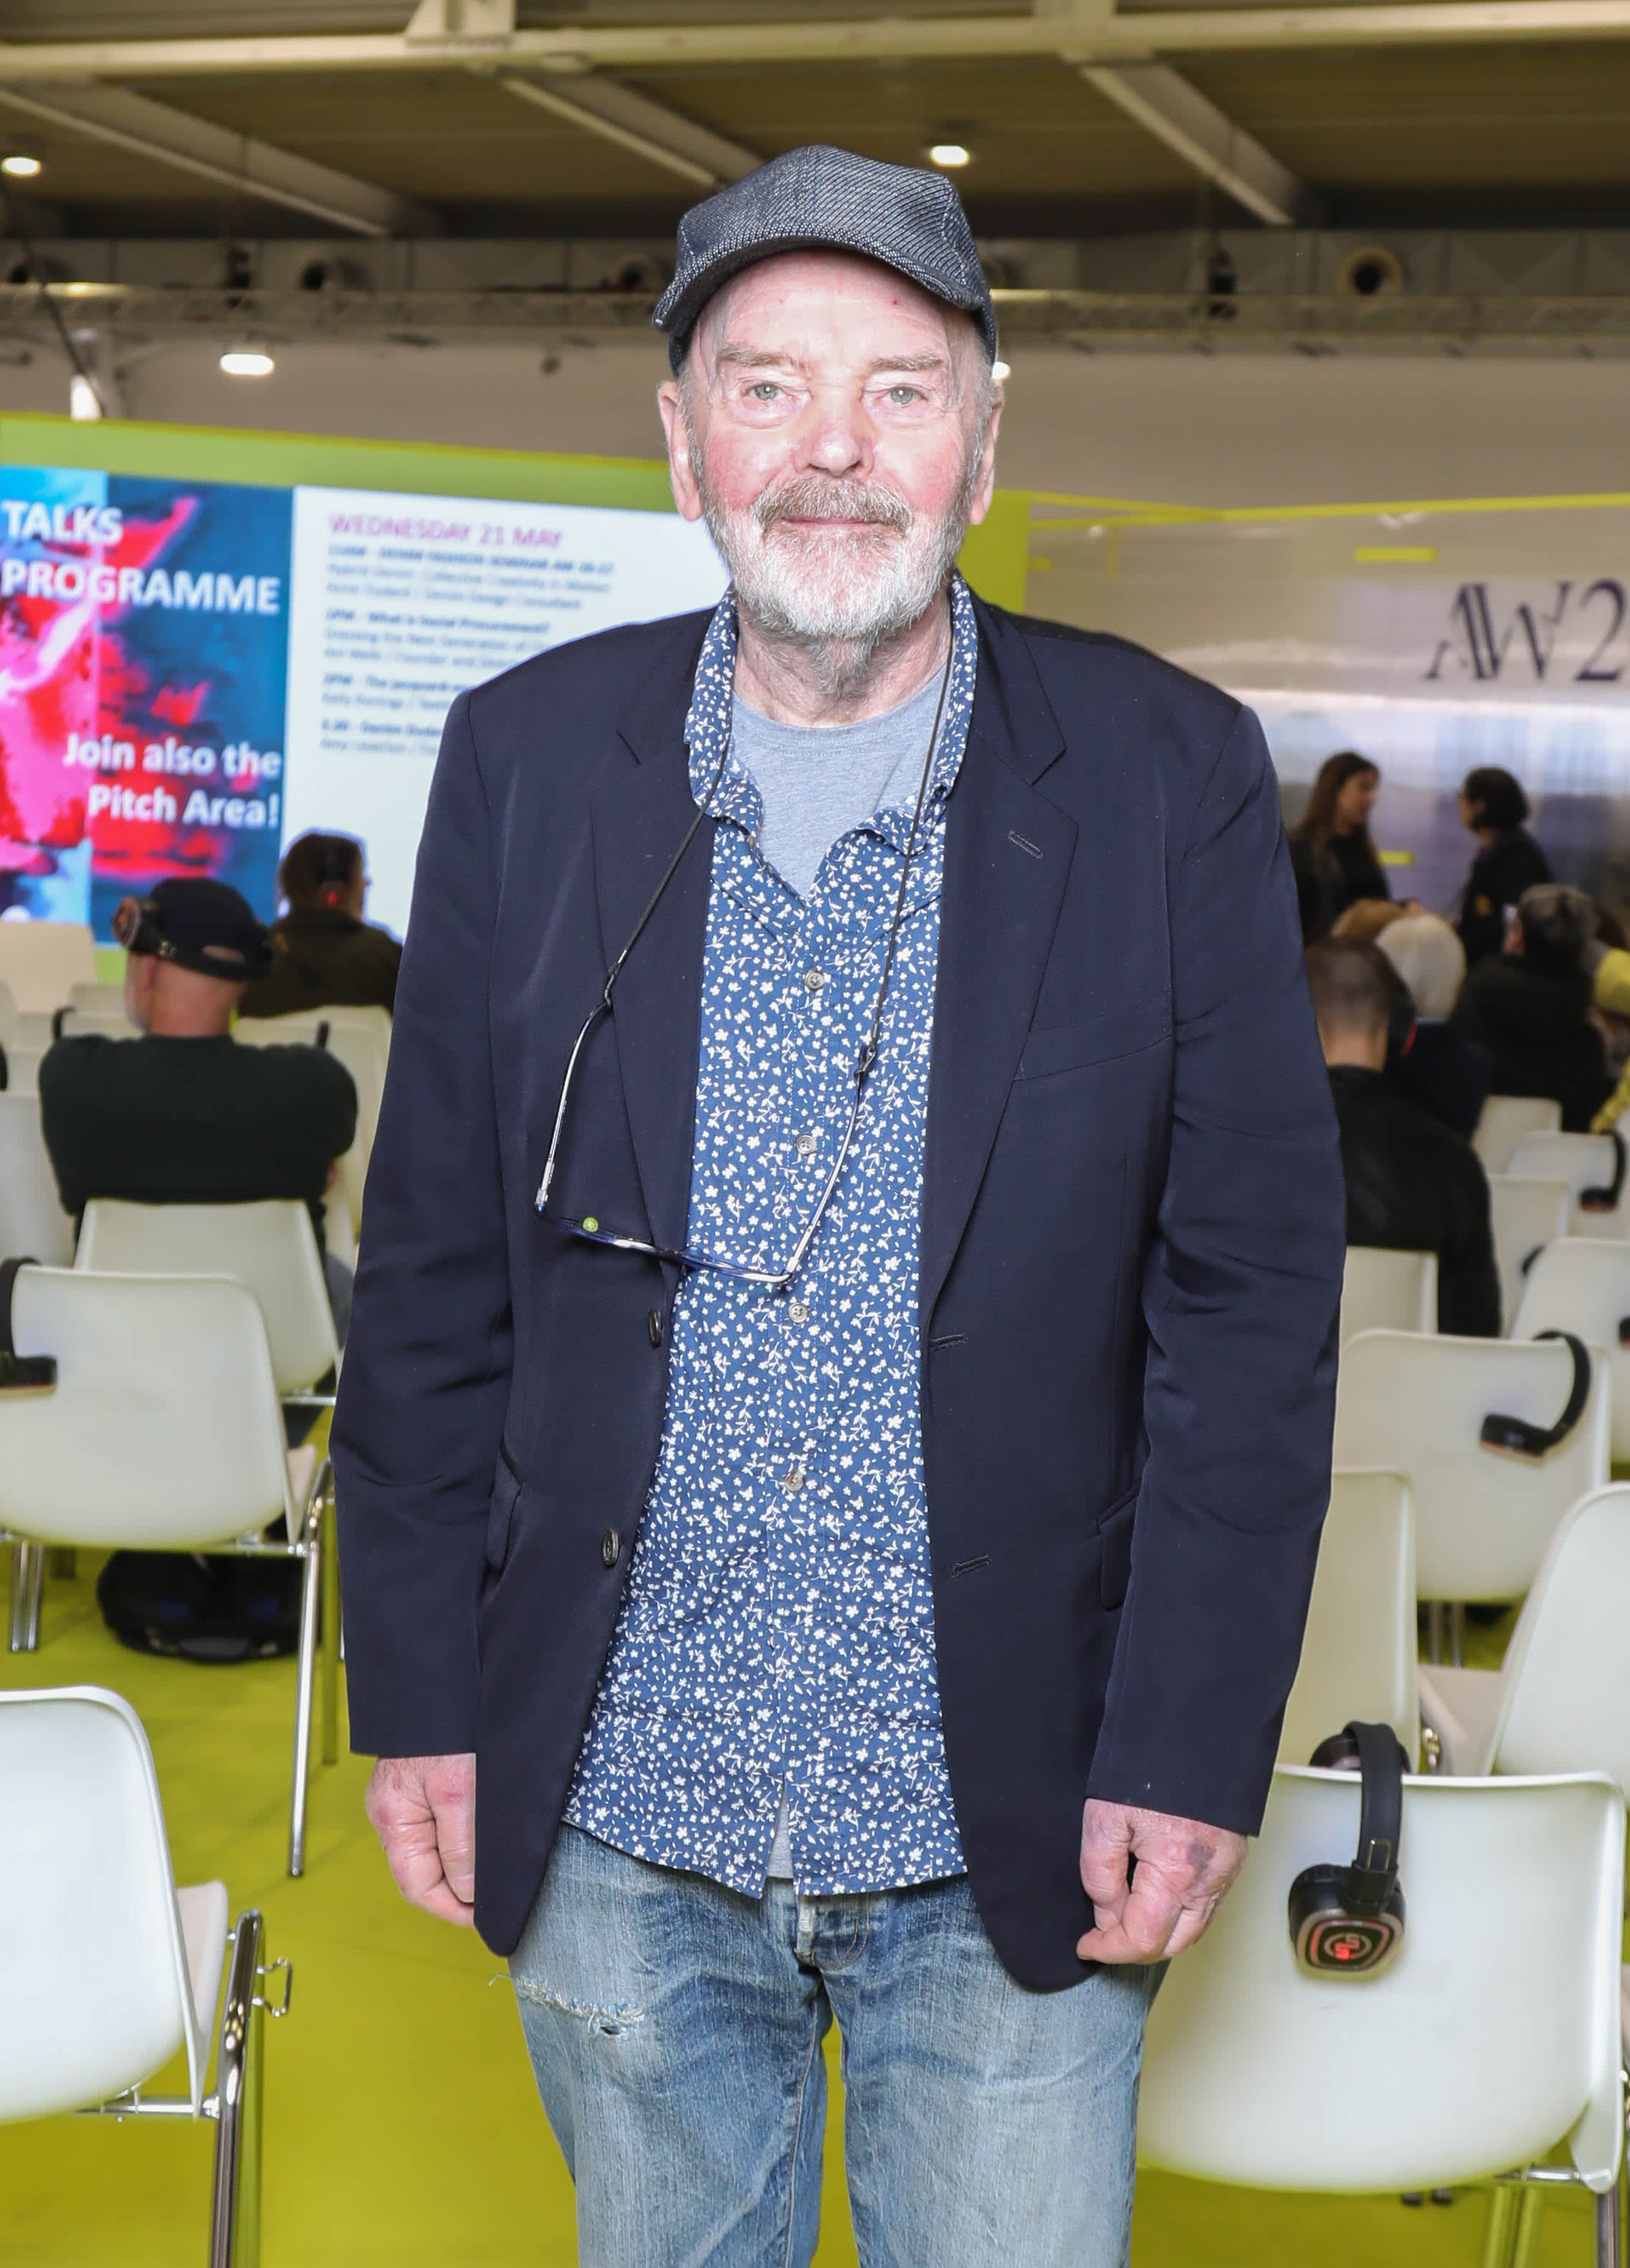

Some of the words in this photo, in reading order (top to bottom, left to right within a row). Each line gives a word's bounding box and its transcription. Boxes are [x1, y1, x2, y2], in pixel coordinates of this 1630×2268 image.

[1, 500, 123, 546] TALKS
[329, 514, 471, 541] WEDNESDAY
[480, 526, 502, 545] 21
[513, 528, 563, 547] MAY
[1, 559, 280, 615] PROGRAMME
[62, 733, 134, 769] Join
[143, 736, 215, 774] also
[222, 742, 281, 778] the
[87, 784, 176, 823] Pitch
[184, 791, 280, 827] Area!
